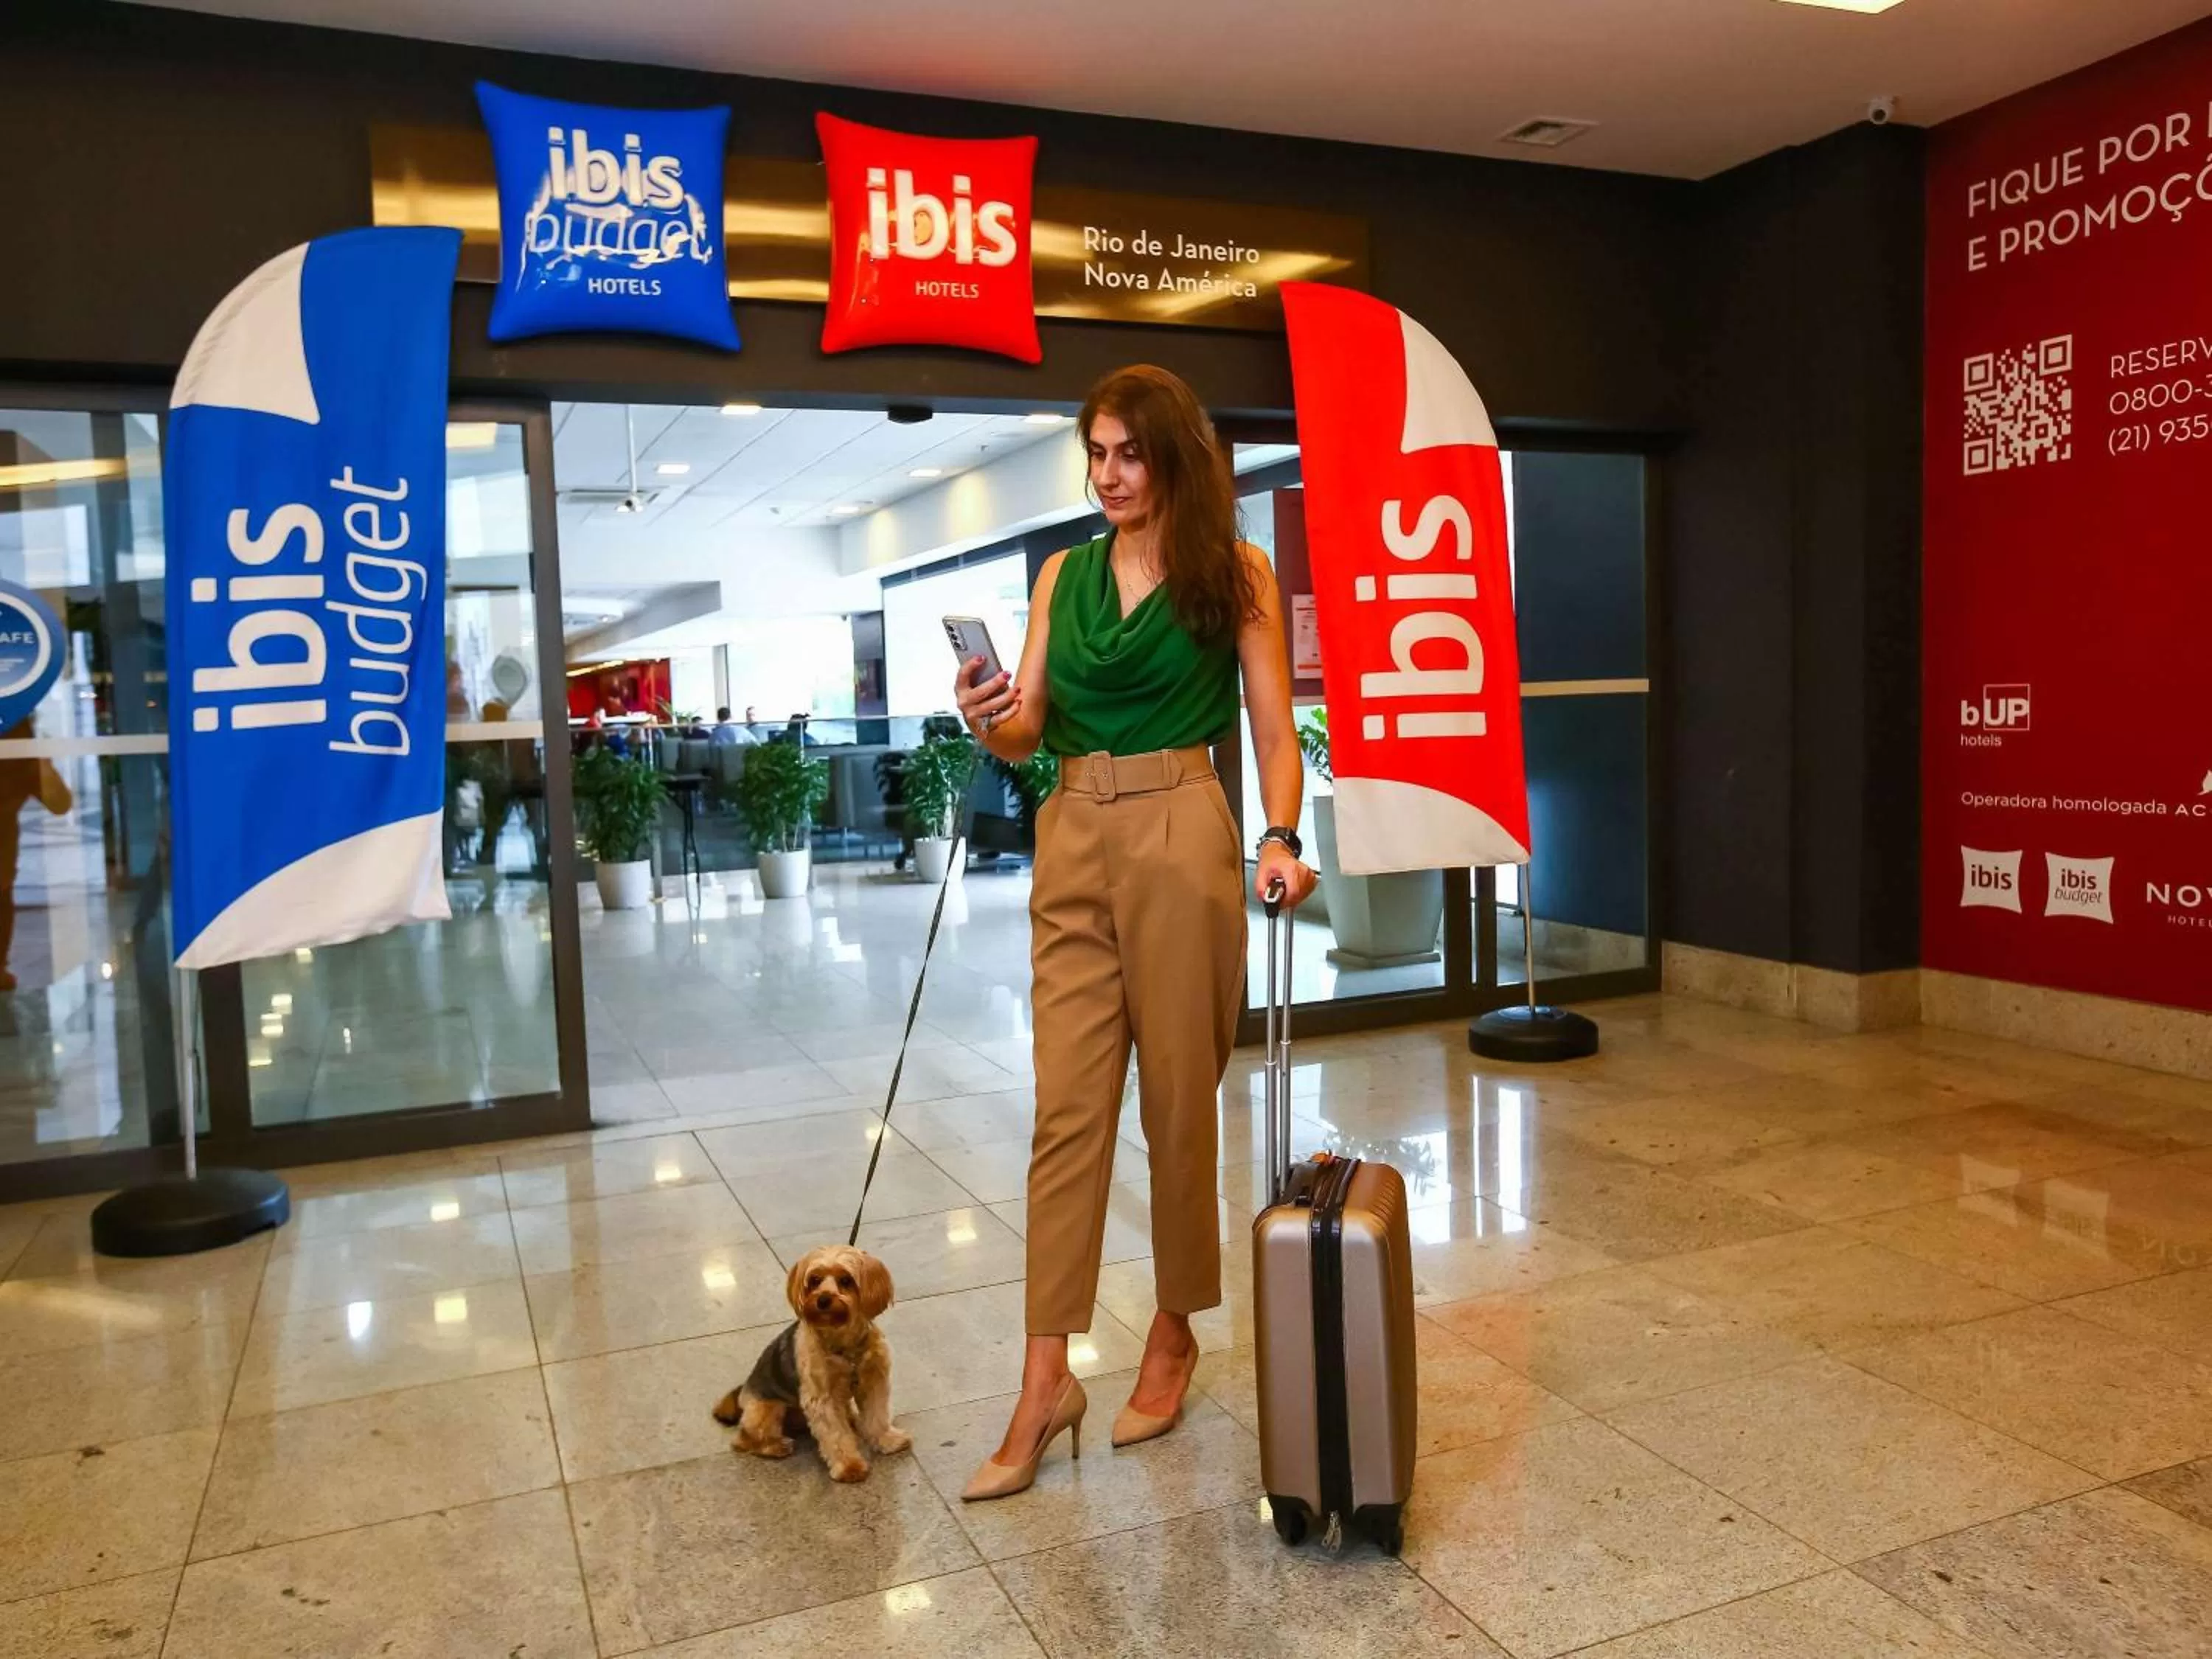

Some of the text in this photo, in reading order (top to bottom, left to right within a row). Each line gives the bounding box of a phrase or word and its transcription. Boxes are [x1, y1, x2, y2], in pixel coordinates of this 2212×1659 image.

[548, 127, 684, 209] ibis
[1968, 147, 2084, 218] FIQUE
[2098, 113, 2191, 174] POR
[866, 167, 1017, 266] ibis
[1083, 226, 1260, 263] Rio de Janeiro
[1968, 236, 1987, 271] E
[588, 278, 661, 296] HOTELS
[915, 280, 979, 299] HOTELS
[1085, 262, 1257, 298] Nova América
[2111, 337, 2212, 378] RESERV
[2108, 414, 2212, 456] (21) 935
[190, 503, 327, 731] ibis
[325, 465, 428, 756] budget
[1354, 495, 1487, 740] ibis
[1961, 734, 2003, 747] hotels
[1961, 791, 2212, 817] Operadora homologada AC
[1970, 864, 2012, 889] ibis
[2060, 869, 2097, 889] ibis
[2053, 887, 2102, 905] budget
[2146, 882, 2212, 908] NO
